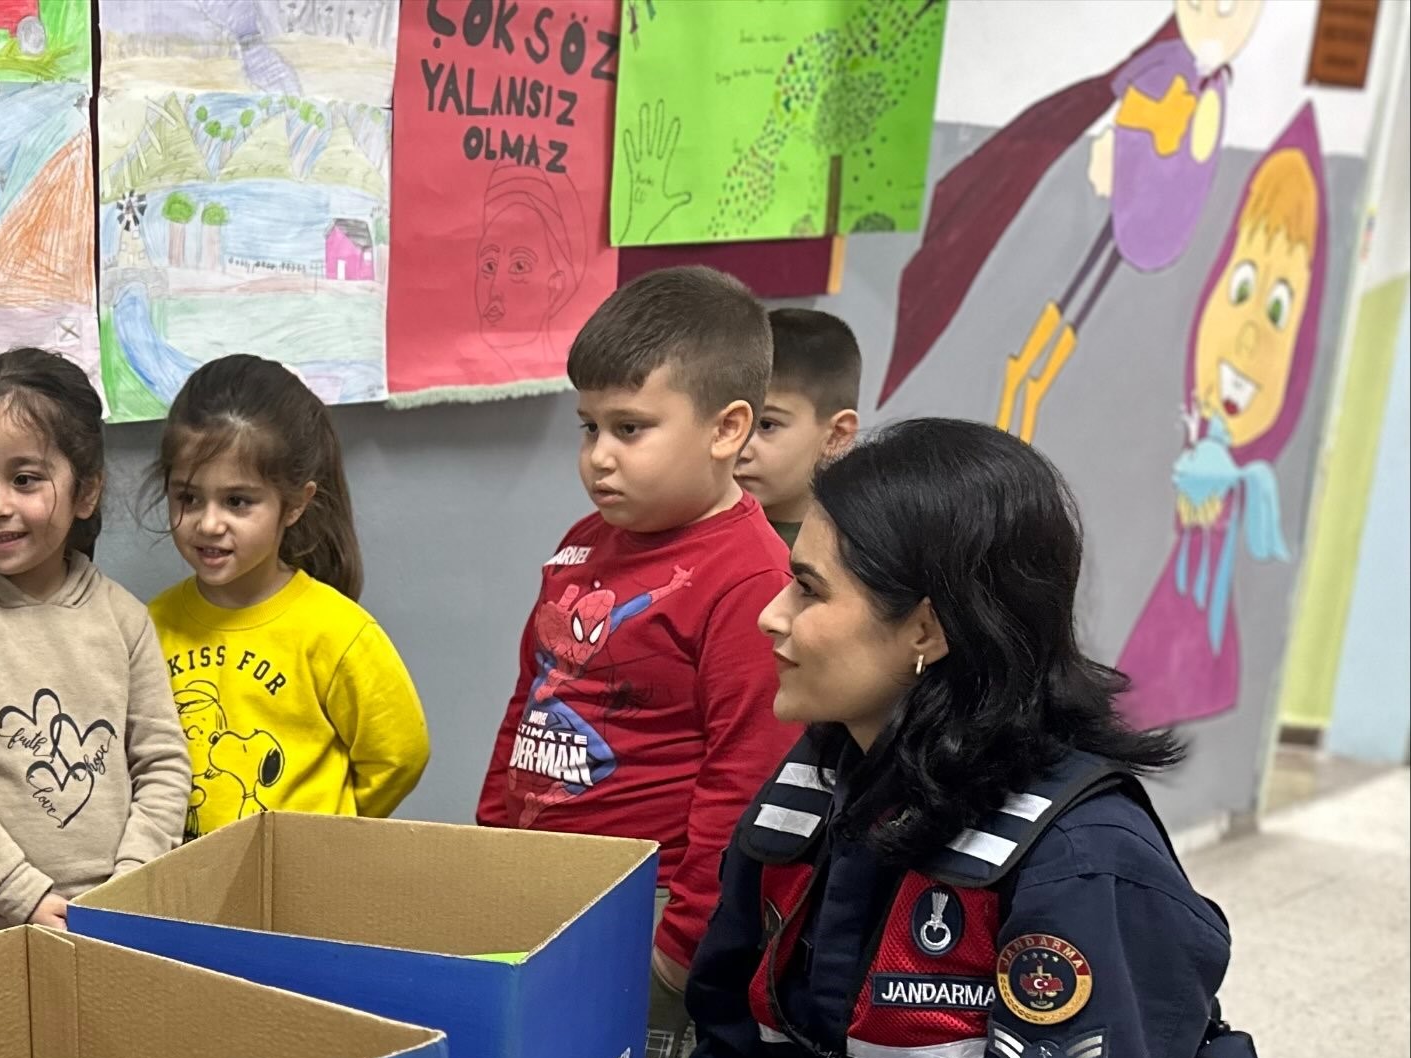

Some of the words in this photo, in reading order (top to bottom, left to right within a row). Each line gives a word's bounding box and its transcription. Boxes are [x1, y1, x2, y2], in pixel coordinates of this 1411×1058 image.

[524, 7, 620, 81] SÖZ
[421, 59, 577, 126] YALANSIZ
[463, 126, 568, 173] OLMAZ
[168, 645, 226, 677] KISS
[236, 650, 286, 695] FOR
[518, 724, 587, 745] TIMATE
[509, 734, 593, 786] DER-MAN
[999, 936, 1085, 969] JANDARMA
[881, 981, 996, 1007] JANDARMA
